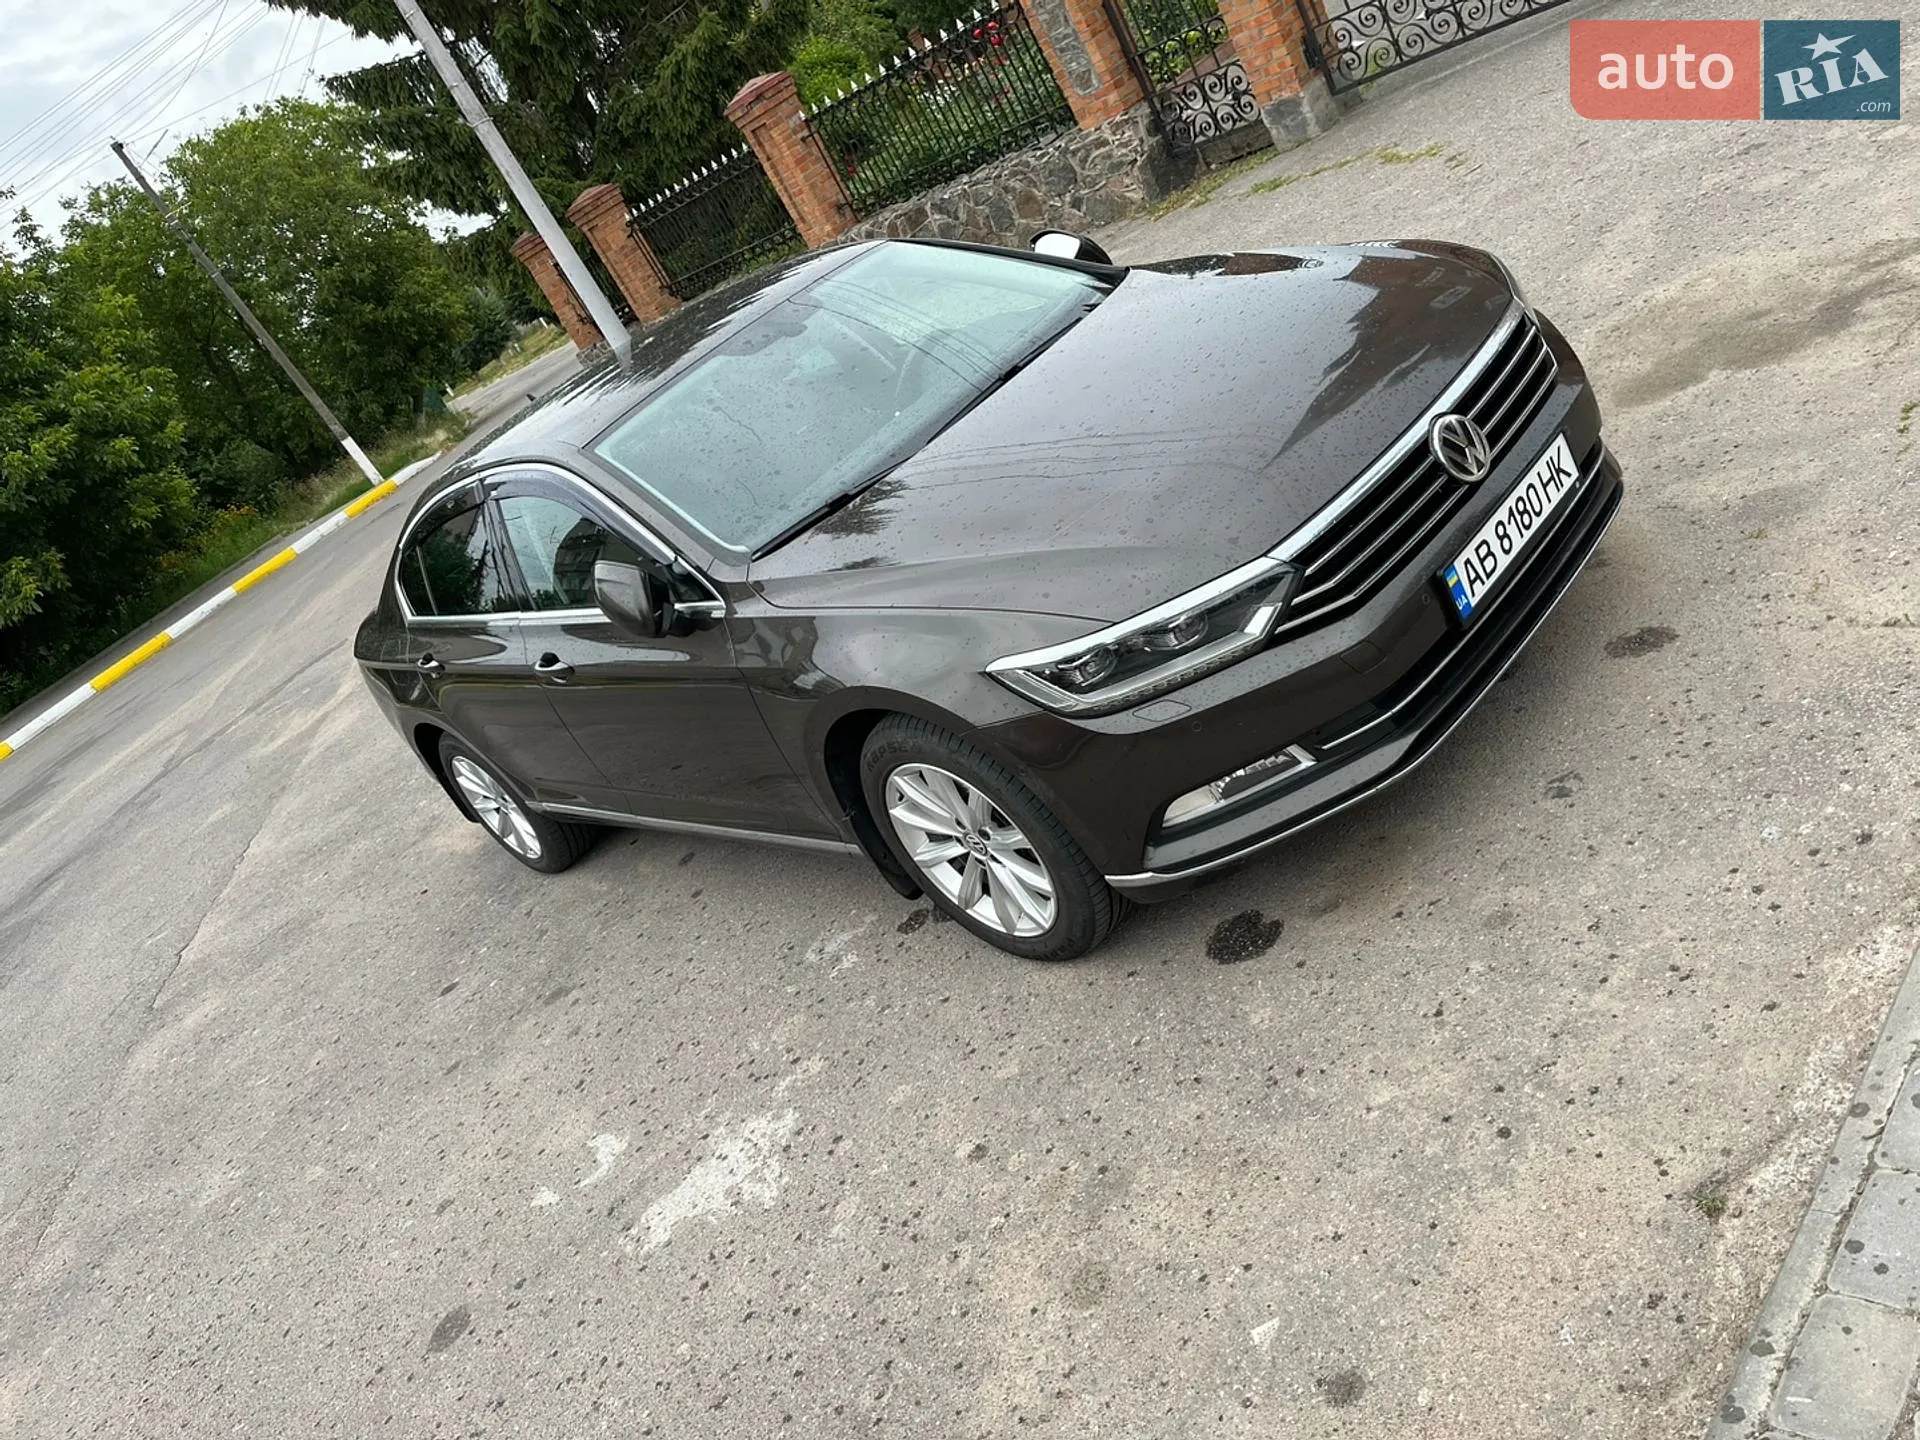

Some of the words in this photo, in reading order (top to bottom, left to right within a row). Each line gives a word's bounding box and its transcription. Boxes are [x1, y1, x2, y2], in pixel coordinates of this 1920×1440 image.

[1462, 539, 1498, 598] AB
[1494, 482, 1544, 556] 8180
[1537, 445, 1573, 504] HK
[1455, 594, 1468, 610] UA
